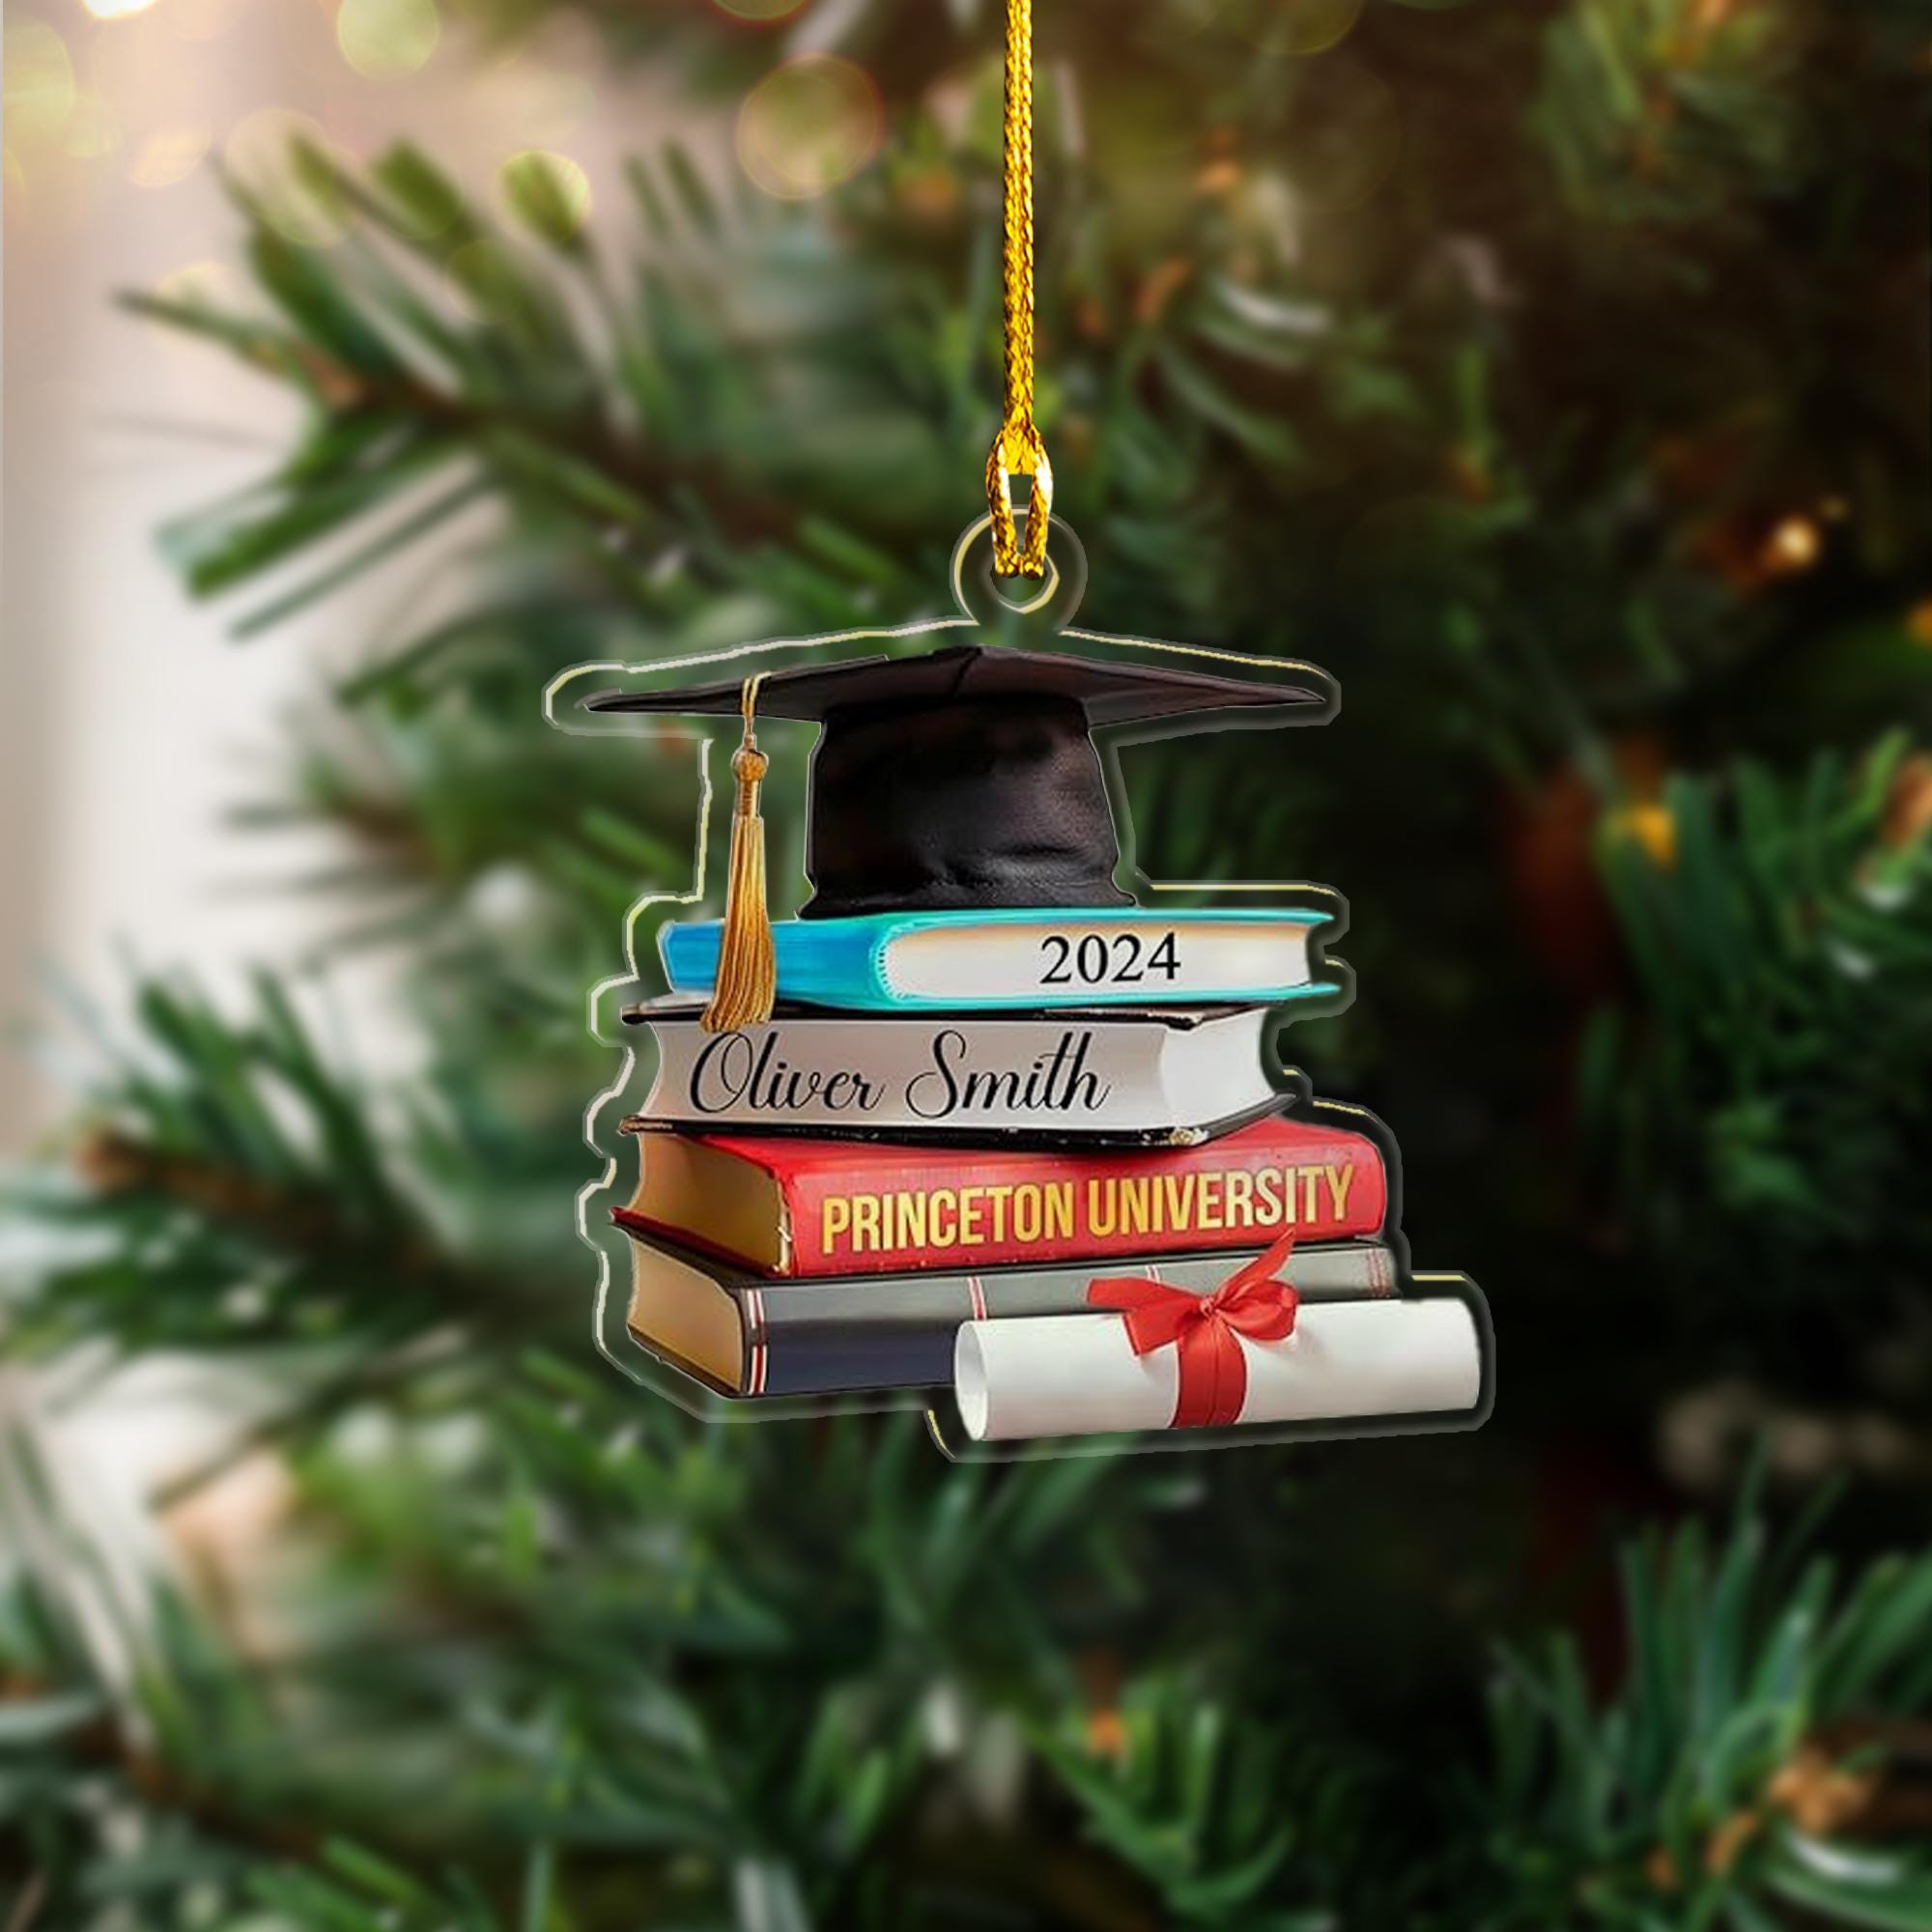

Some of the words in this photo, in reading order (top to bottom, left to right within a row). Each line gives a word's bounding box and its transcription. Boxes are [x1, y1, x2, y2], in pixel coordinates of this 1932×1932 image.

[1039, 931, 1181, 983] 2024
[690, 1031, 887, 1114] Oliver
[905, 1030, 1111, 1119] Smith
[821, 1180, 1074, 1254] PRINCETON
[1088, 1163, 1354, 1235] UNIVERSITY
